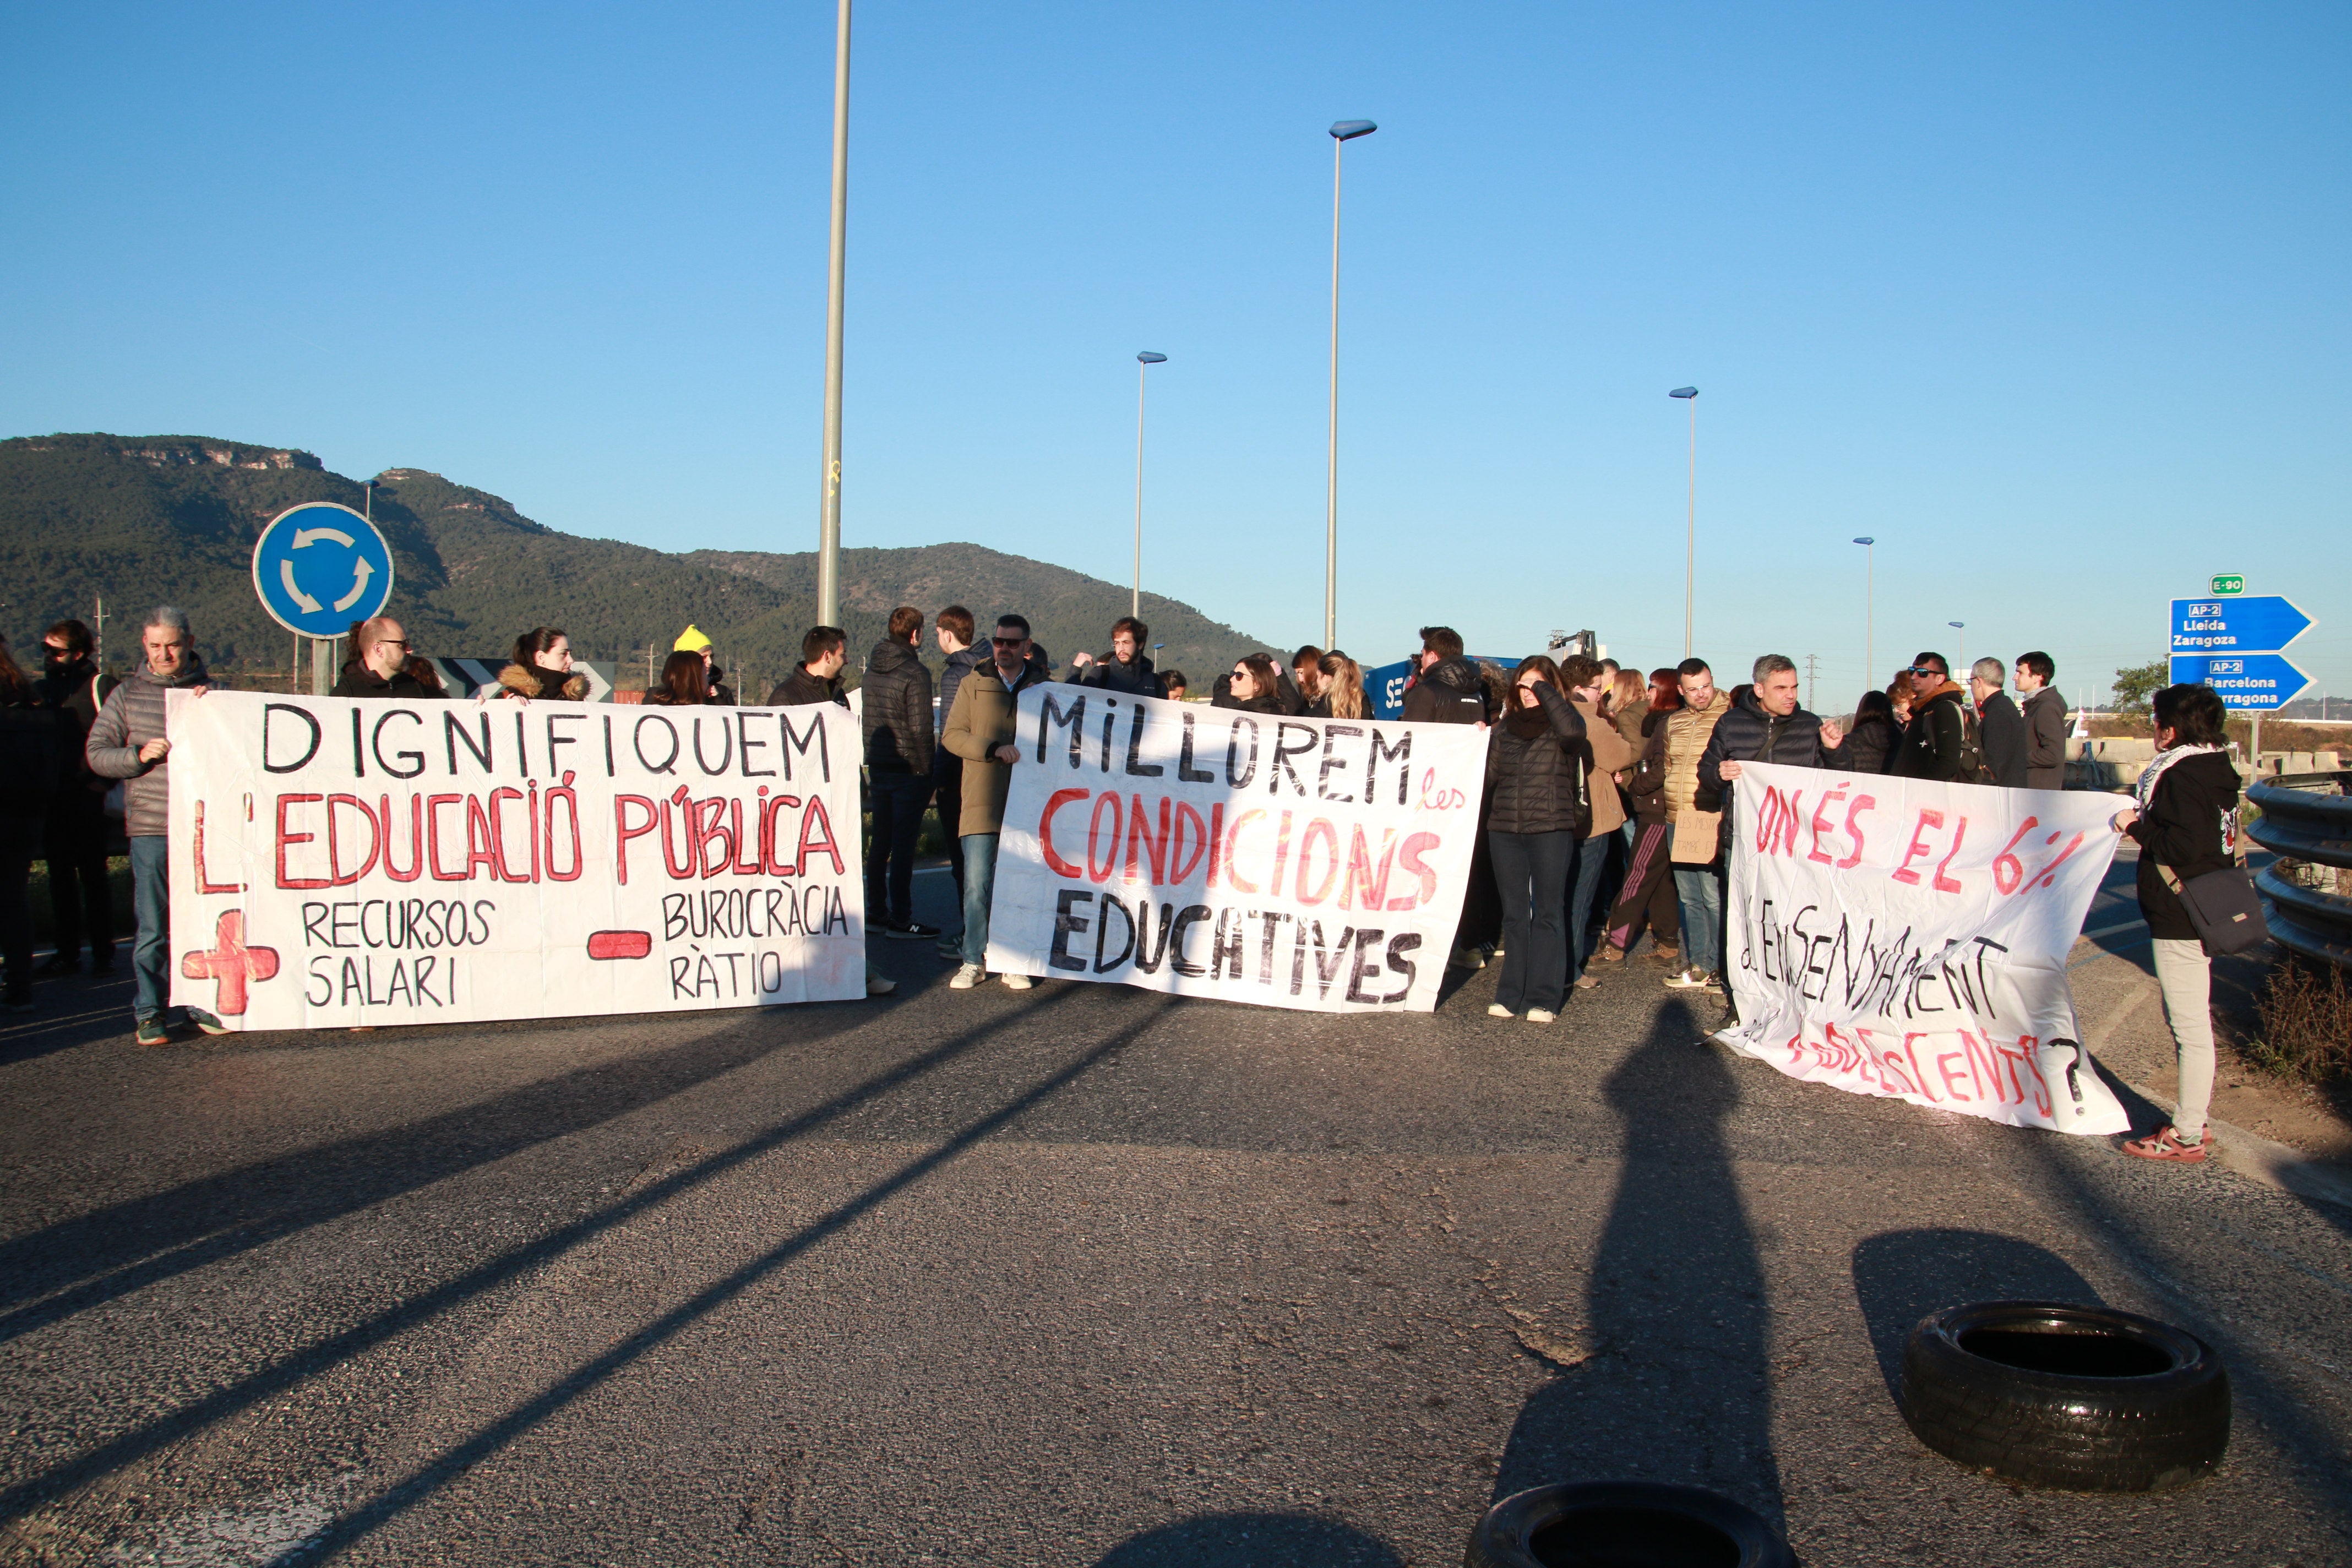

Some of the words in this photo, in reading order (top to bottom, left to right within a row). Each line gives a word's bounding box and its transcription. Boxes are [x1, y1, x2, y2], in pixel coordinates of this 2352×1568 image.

[2213, 580, 2241, 590] E-90
[2183, 620, 2226, 631] Lleida
[2191, 606, 2219, 616] AP-2
[2173, 635, 2236, 647] Zaragoza
[2204, 677, 2277, 688] Barcelona
[2212, 662, 2241, 672] AP-2
[2218, 694, 2278, 706] rragona
[263, 703, 830, 783] DIGNIFIQUEM
[1414, 766, 1466, 814] les
[1039, 788, 1441, 911] CONDICIONS
[1756, 785, 1803, 859] ON
[1807, 781, 1876, 869] ÉS
[1891, 809, 1968, 894] EL
[302, 899, 496, 950] RECURSOS
[662, 881, 848, 941] BUROCRÀCIA
[1048, 889, 1422, 1004] EDUCATIVES
[306, 955, 456, 1008] SALARI
[669, 944, 782, 1000] RÀTIO
